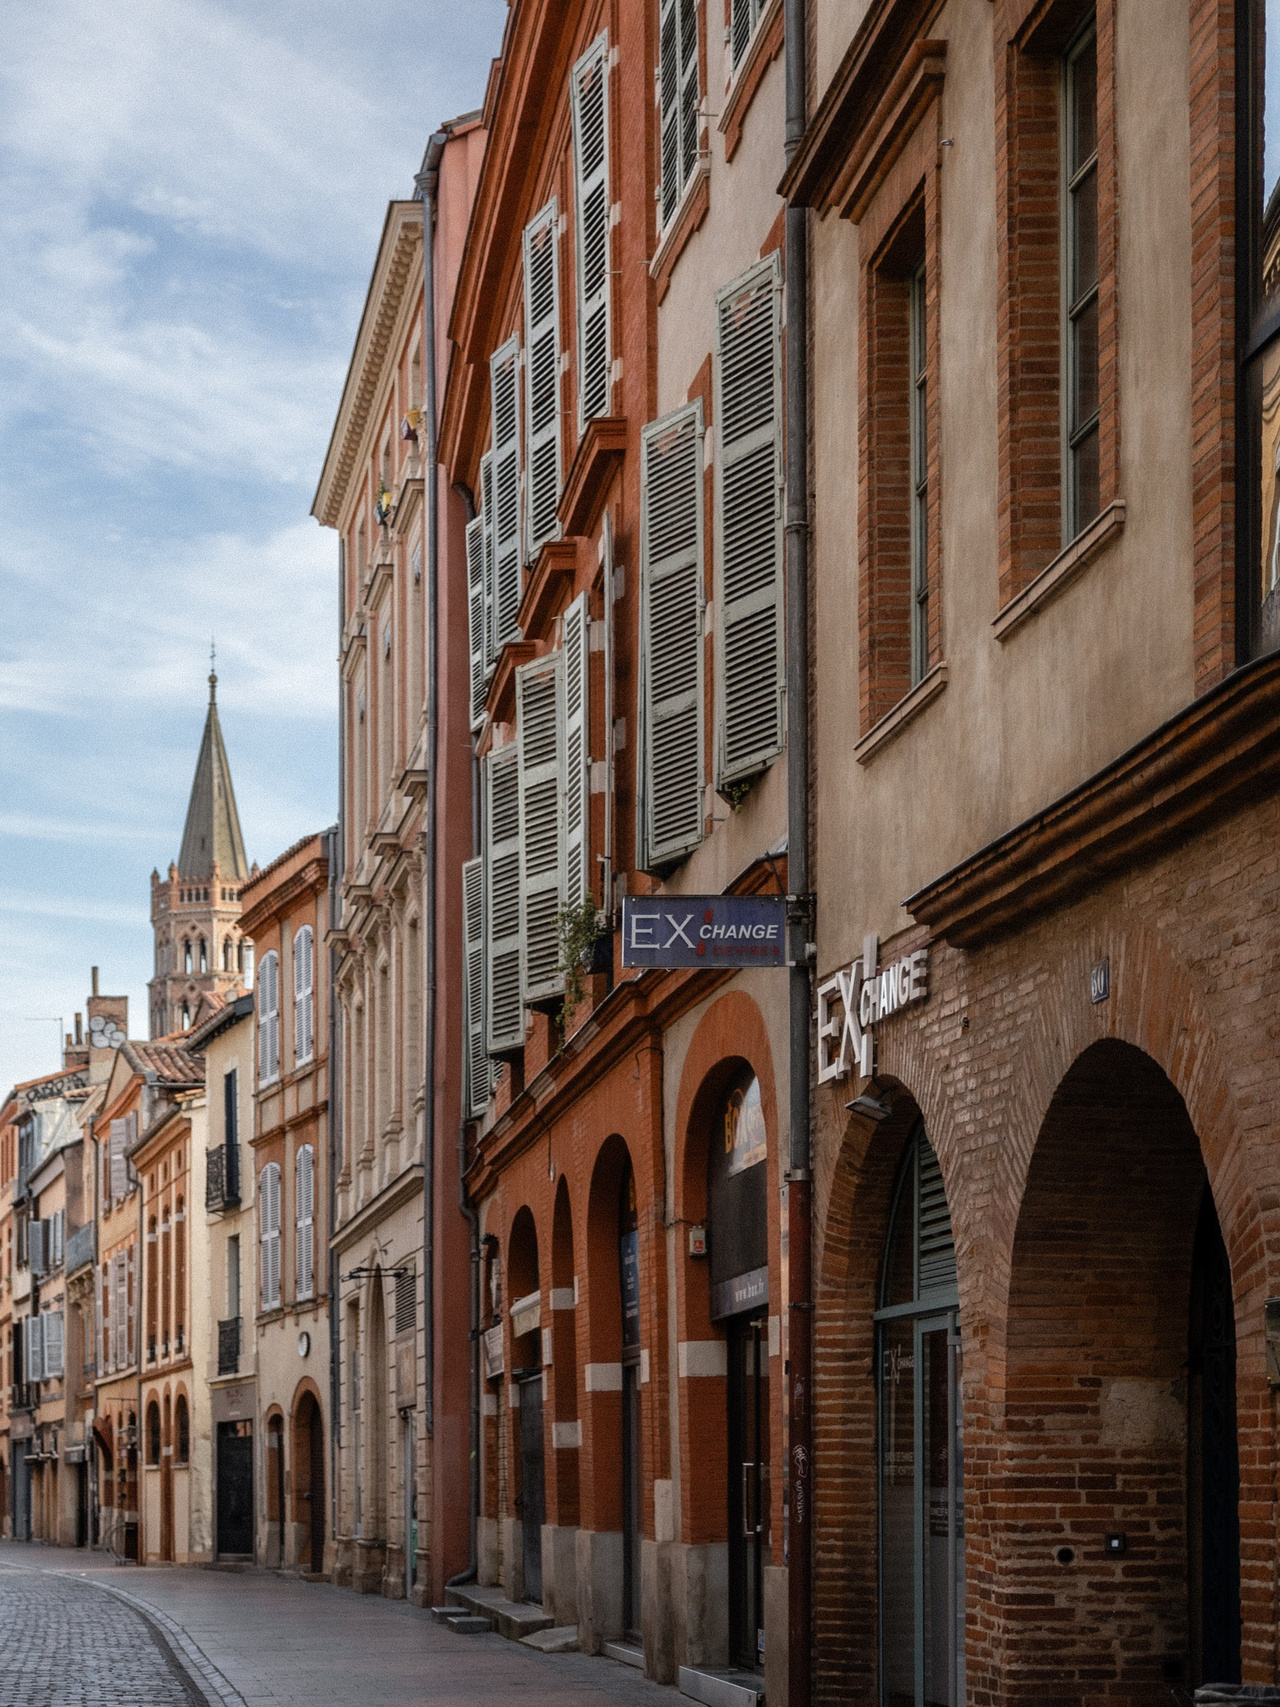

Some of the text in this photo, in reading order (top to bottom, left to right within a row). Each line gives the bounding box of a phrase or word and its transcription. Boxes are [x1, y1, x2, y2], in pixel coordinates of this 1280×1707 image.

[699, 924, 779, 939] CHANGE
[713, 945, 780, 956] DEVISES
[860, 948, 928, 1028] CHANGE
